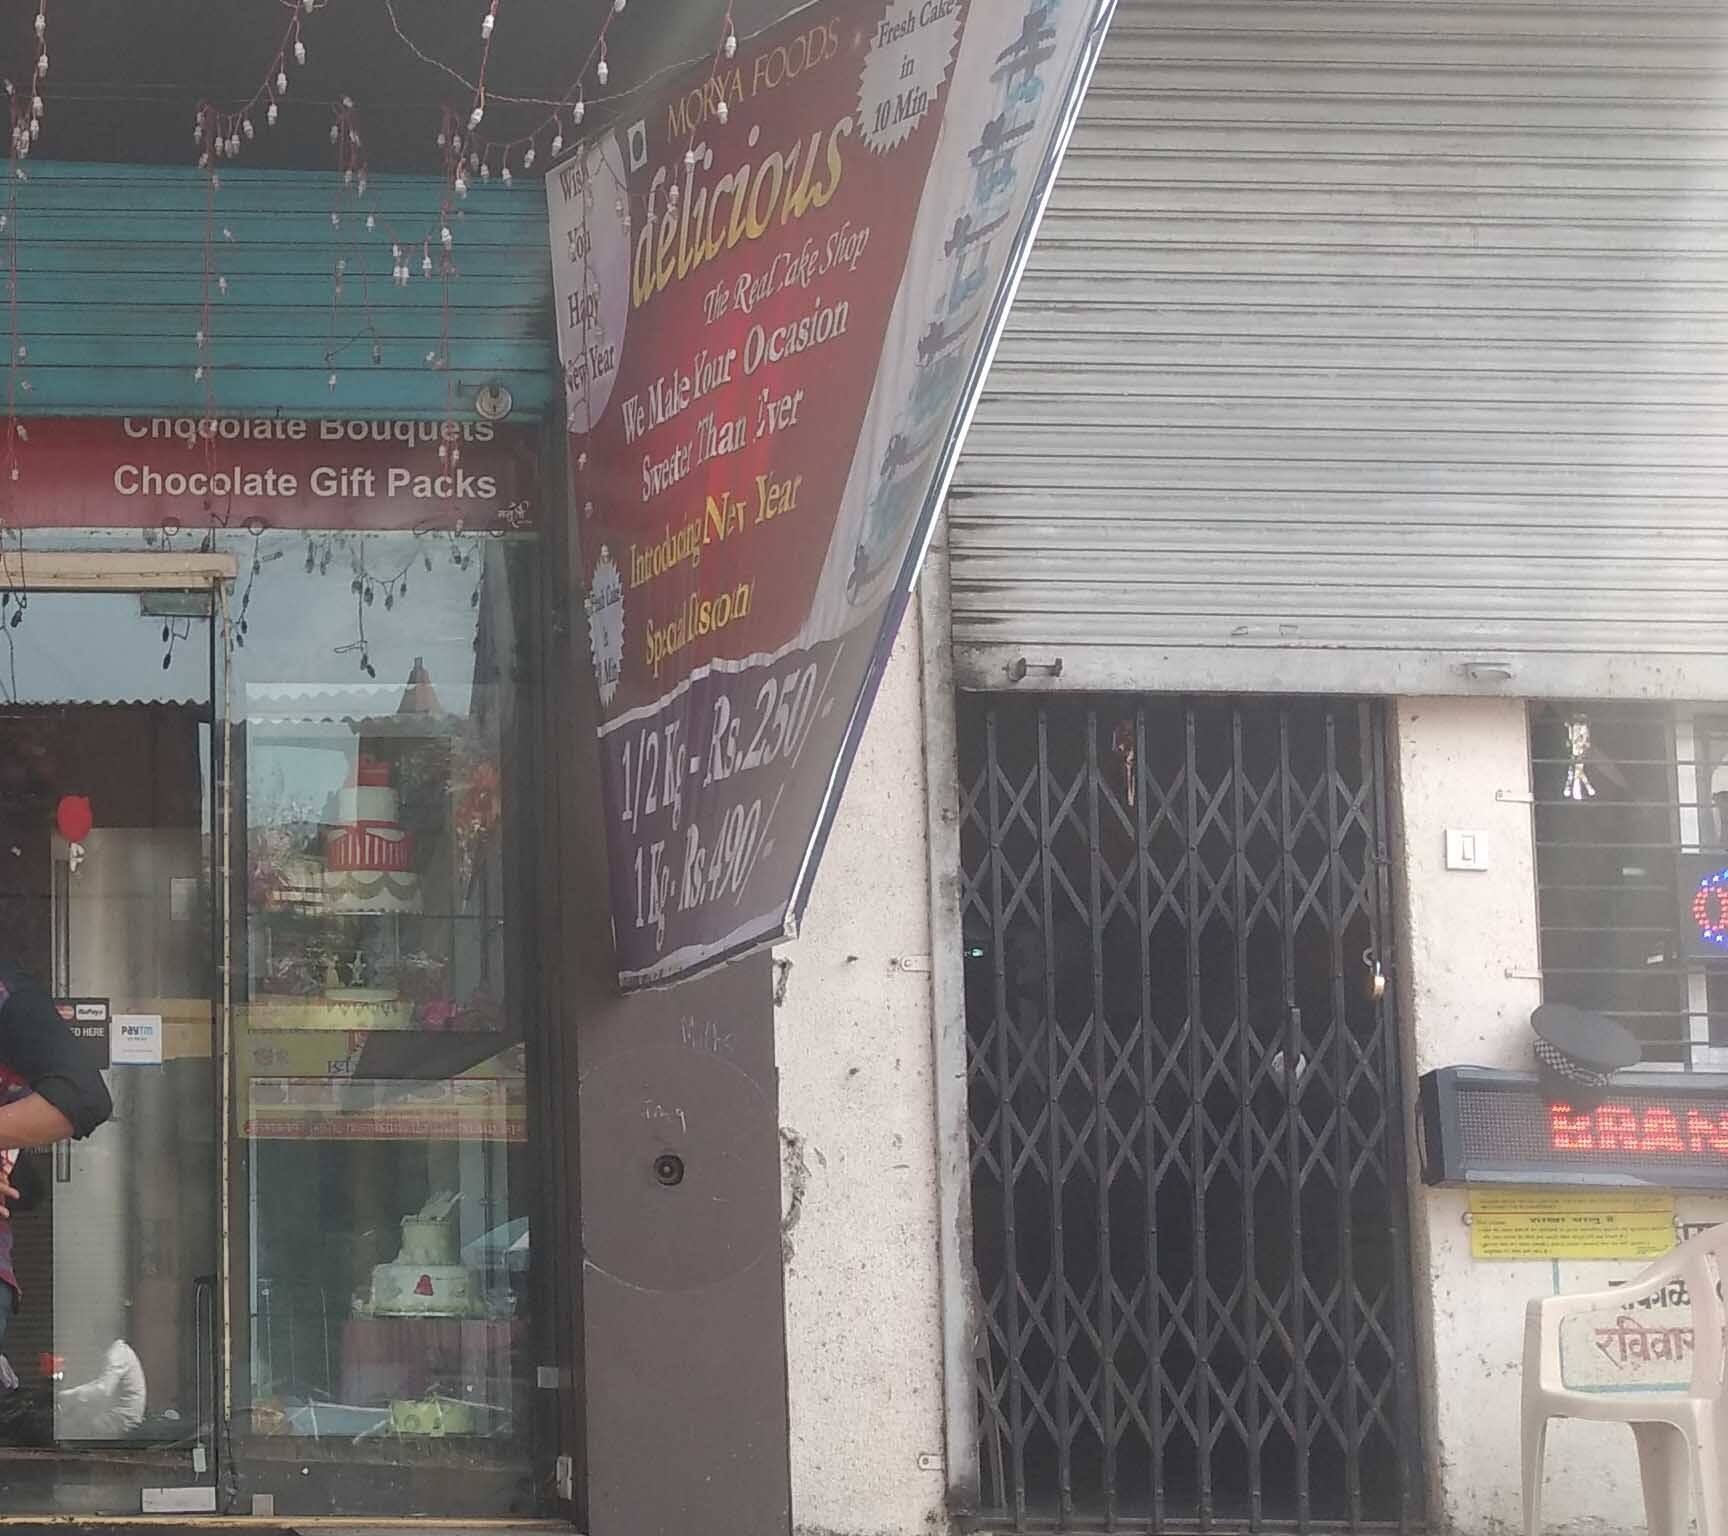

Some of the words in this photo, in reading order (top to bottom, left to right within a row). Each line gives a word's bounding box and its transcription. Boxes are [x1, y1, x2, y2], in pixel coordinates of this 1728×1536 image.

[877, 6, 918, 50] Fresh
[750, 16, 840, 95] FOODS
[899, 53, 915, 78] in
[872, 104, 890, 136] 10
[892, 87, 929, 130] Min
[633, 115, 854, 309] delicious
[820, 221, 871, 274] Shop
[588, 343, 615, 384] Year
[621, 393, 646, 445] We
[648, 366, 692, 431] Make
[692, 348, 737, 401] Your
[695, 410, 748, 465] Than
[114, 464, 298, 498] Chocolate
[309, 464, 376, 497] Gift
[387, 465, 498, 499] Packs
[82, 1027, 105, 1037] HERE
